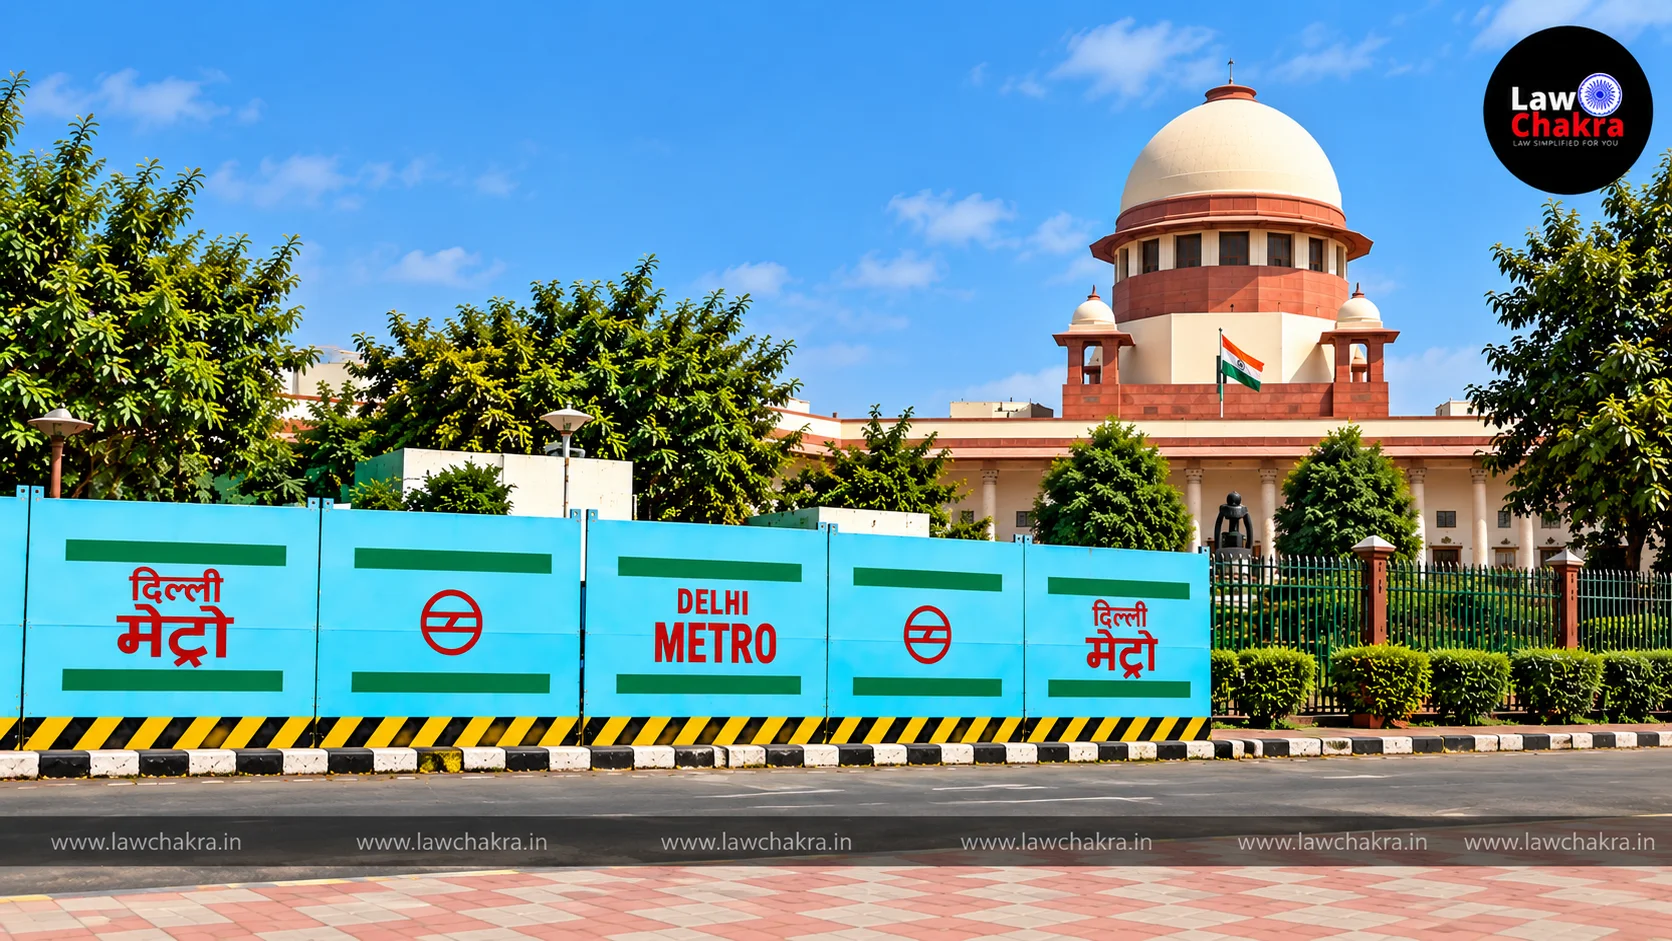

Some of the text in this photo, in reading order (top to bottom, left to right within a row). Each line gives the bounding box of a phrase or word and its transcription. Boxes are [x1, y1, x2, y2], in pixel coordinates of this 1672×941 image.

[128, 565, 225, 604] दिल्ली
[677, 588, 749, 616] DELHI
[1092, 599, 1148, 629] दिल्ली
[116, 603, 235, 668] मेट्रो
[654, 621, 777, 664] METRO
[1085, 629, 1159, 679] मेट्रो
